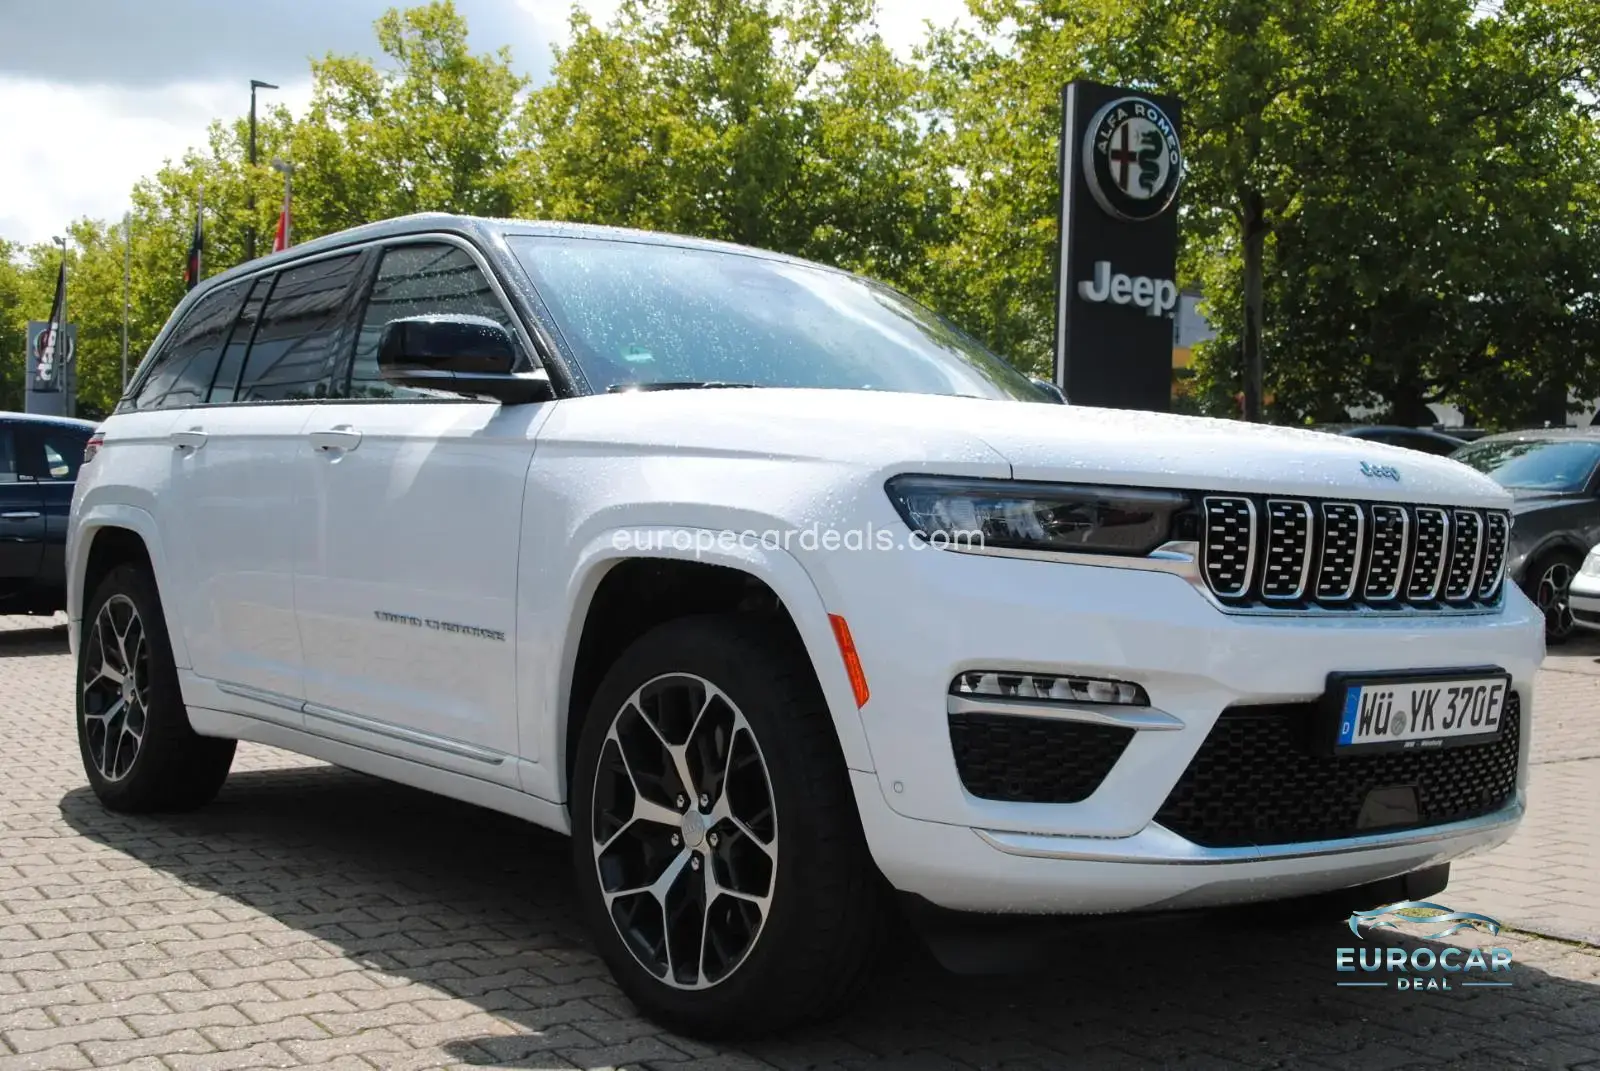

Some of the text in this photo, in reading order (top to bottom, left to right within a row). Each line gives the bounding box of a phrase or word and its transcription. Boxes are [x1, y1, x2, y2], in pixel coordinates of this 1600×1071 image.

[1097, 103, 1178, 165] ALFA ROMEO
[1078, 260, 1176, 317] Jeep
[1360, 460, 1400, 482] Jeep
[1410, 688, 1441, 733] YK
[1442, 684, 1503, 730] 370E
